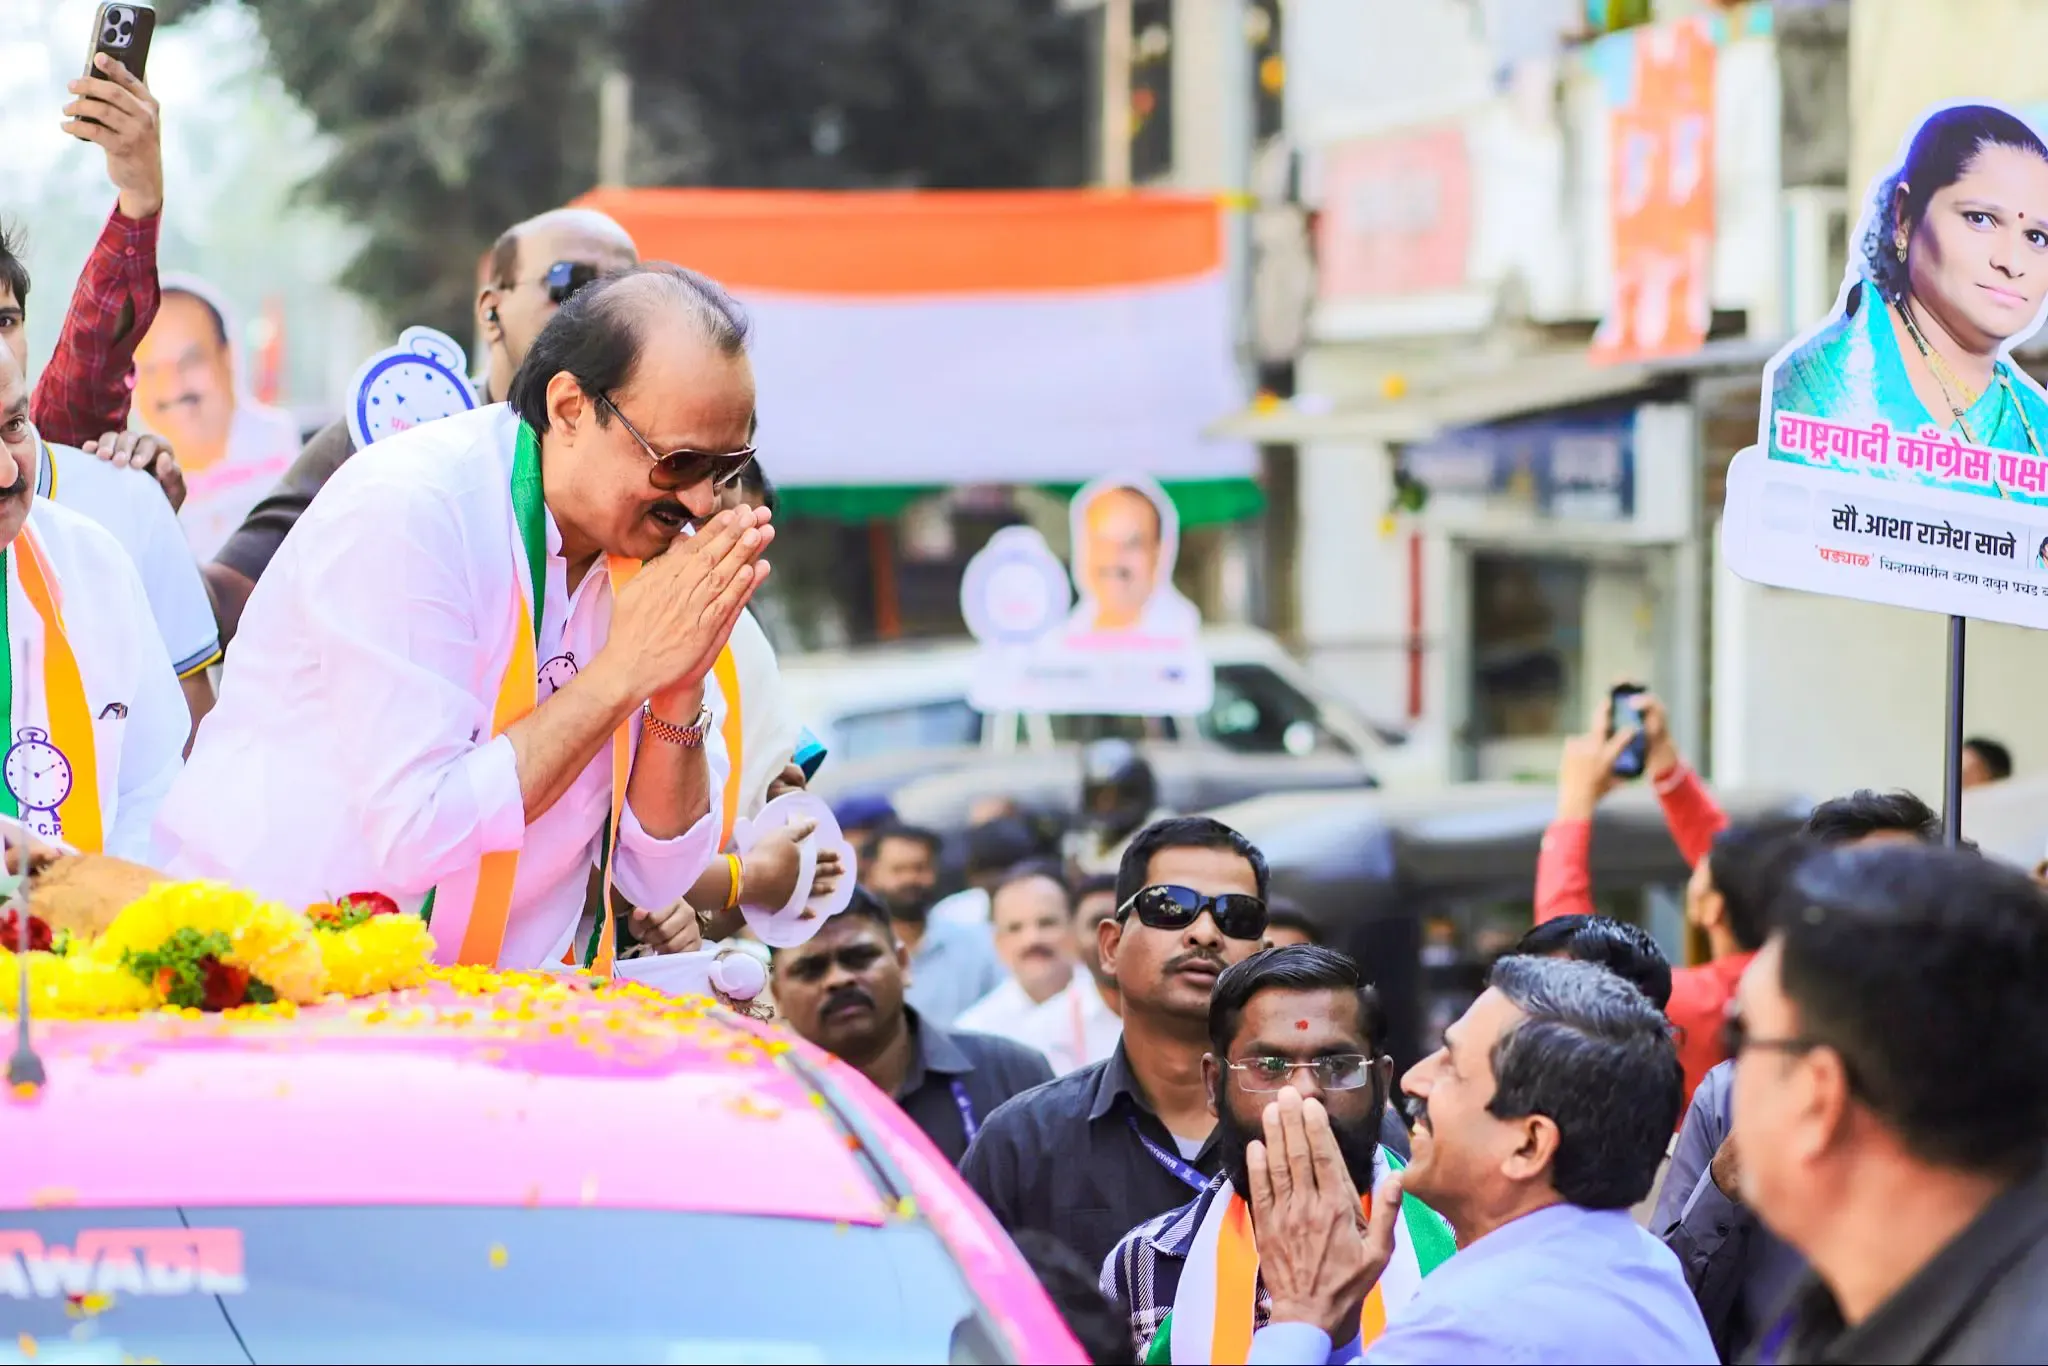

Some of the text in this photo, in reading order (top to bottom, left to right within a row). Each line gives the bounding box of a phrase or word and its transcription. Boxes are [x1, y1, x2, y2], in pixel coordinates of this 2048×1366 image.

[1779, 415, 1890, 465] राष्ट्रवादी
[1896, 428, 1993, 481] काँग्रेस
[1917, 520, 1971, 551] राजेश
[1974, 531, 2017, 560] साने
